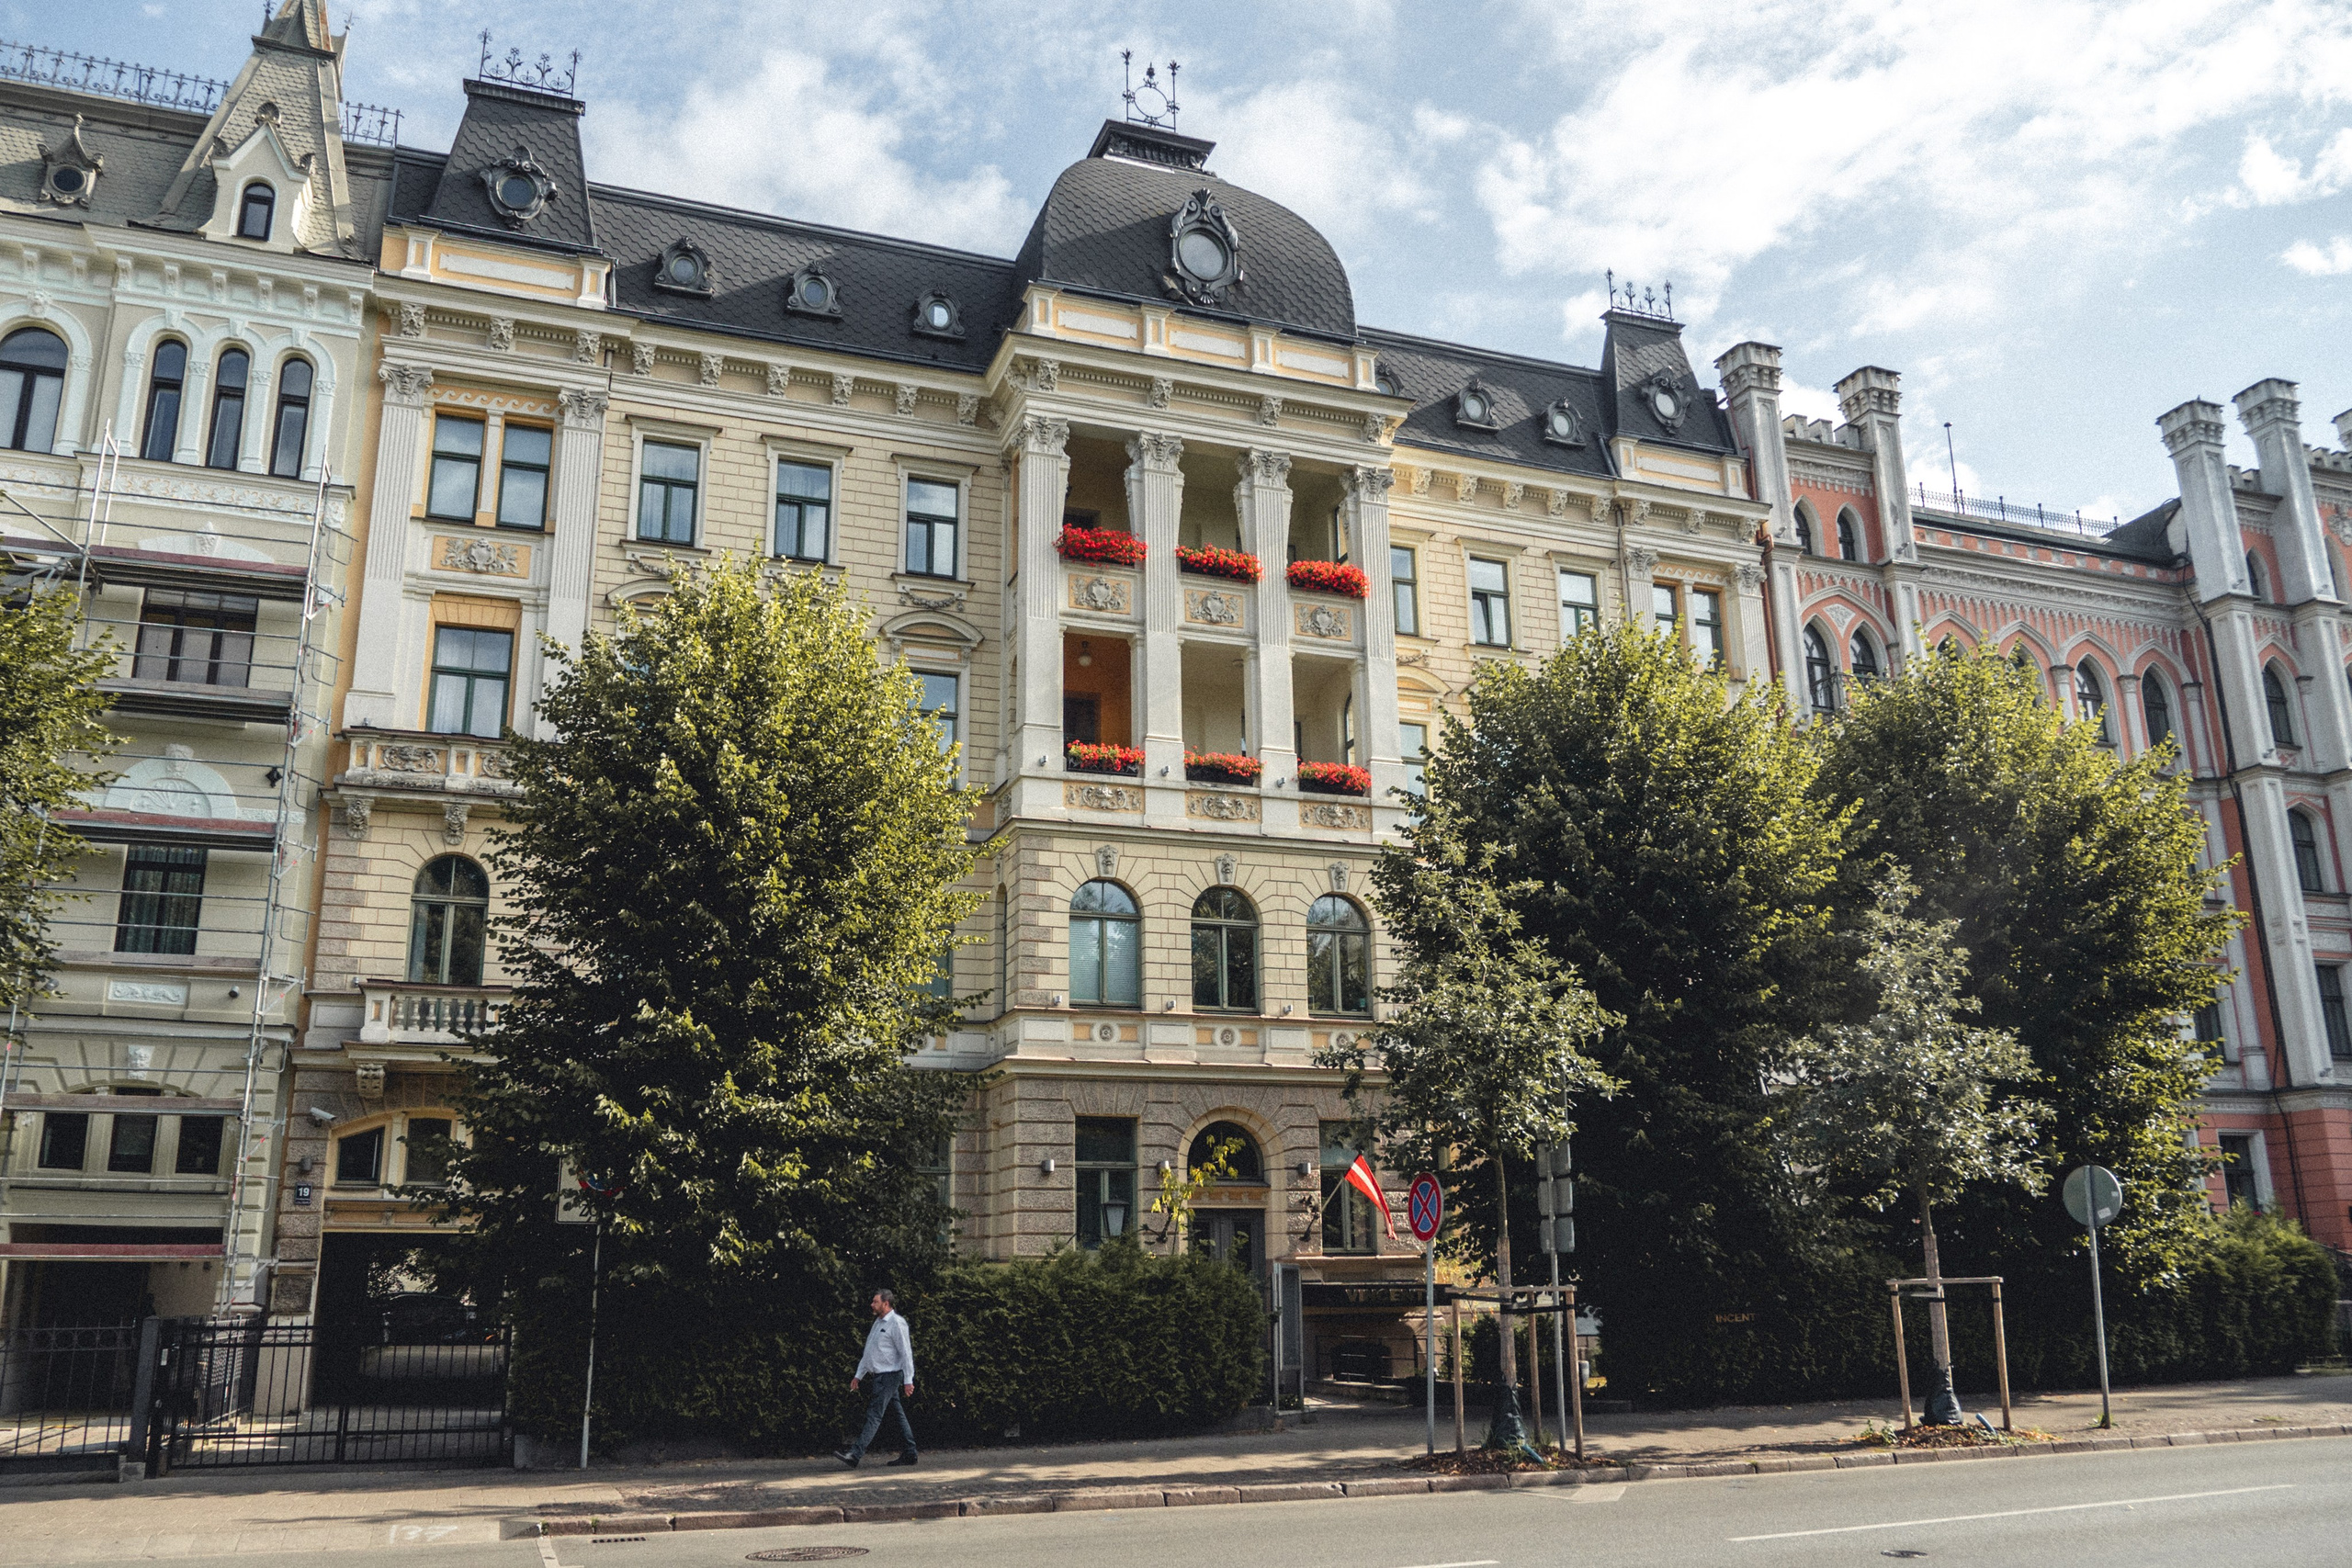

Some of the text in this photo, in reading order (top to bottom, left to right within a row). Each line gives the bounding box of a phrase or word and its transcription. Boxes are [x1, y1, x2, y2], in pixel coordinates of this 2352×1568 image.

[298, 1188, 310, 1196] 19
[1344, 1288, 1428, 1303] VINCENT
[1714, 1313, 1757, 1323] INCENT
